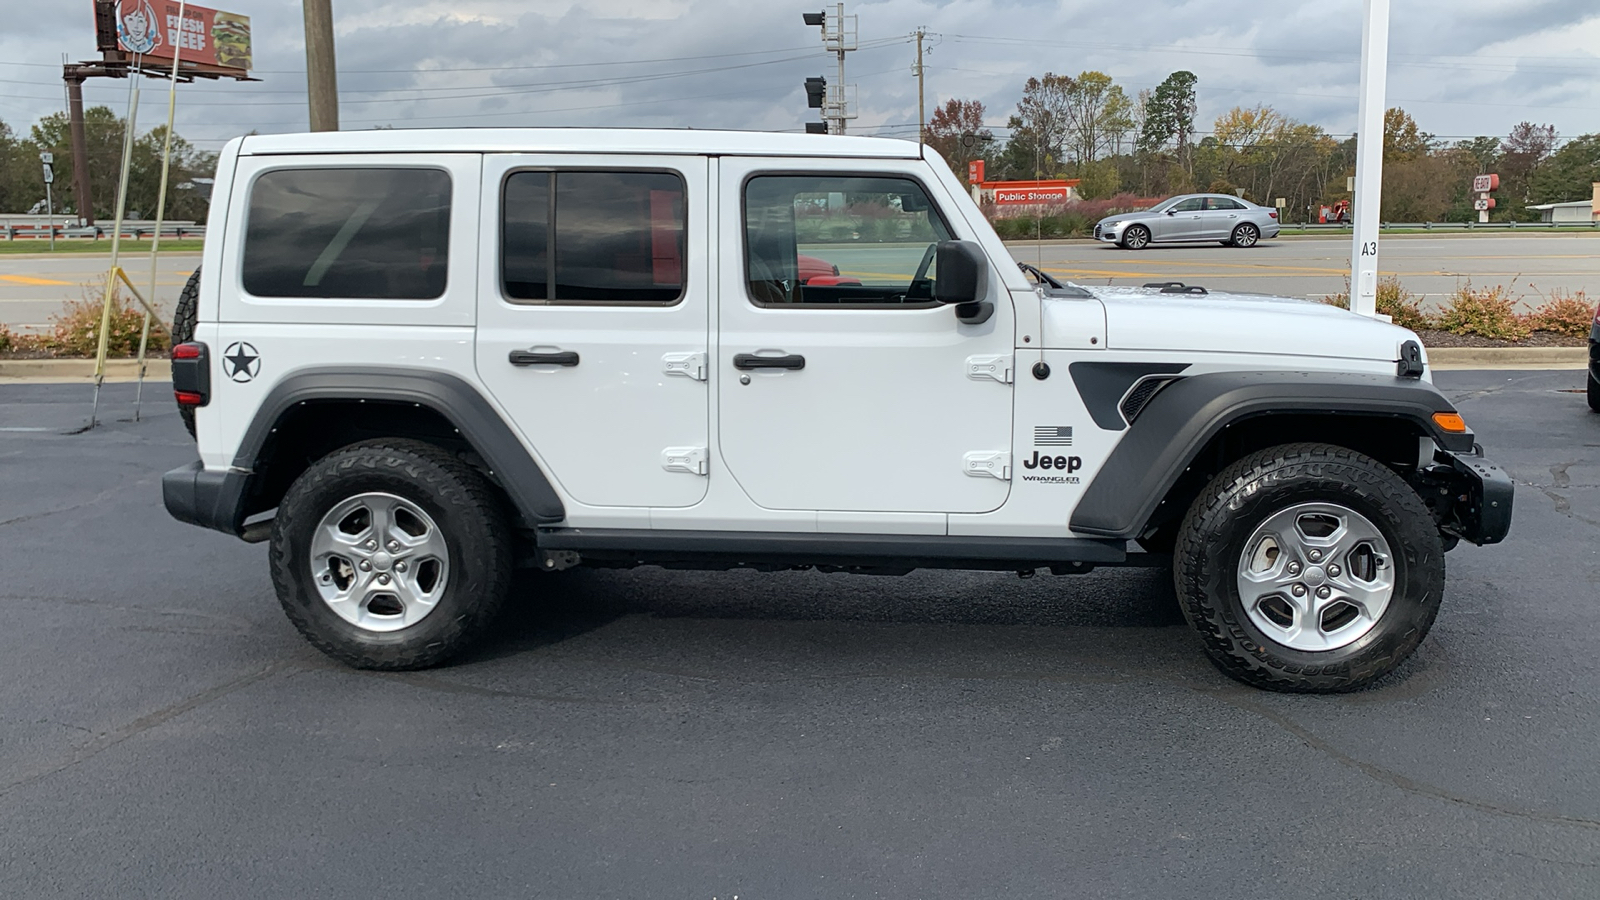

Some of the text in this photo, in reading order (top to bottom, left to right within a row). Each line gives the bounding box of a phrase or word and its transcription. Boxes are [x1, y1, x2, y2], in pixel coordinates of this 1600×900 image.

[193, 11, 203, 19] ON
[166, 14, 205, 34] FRESH
[167, 28, 206, 51] BEEF
[999, 192, 1063, 202] Public Storage
[1361, 241, 1377, 256] A3
[1023, 450, 1082, 474] Jeep
